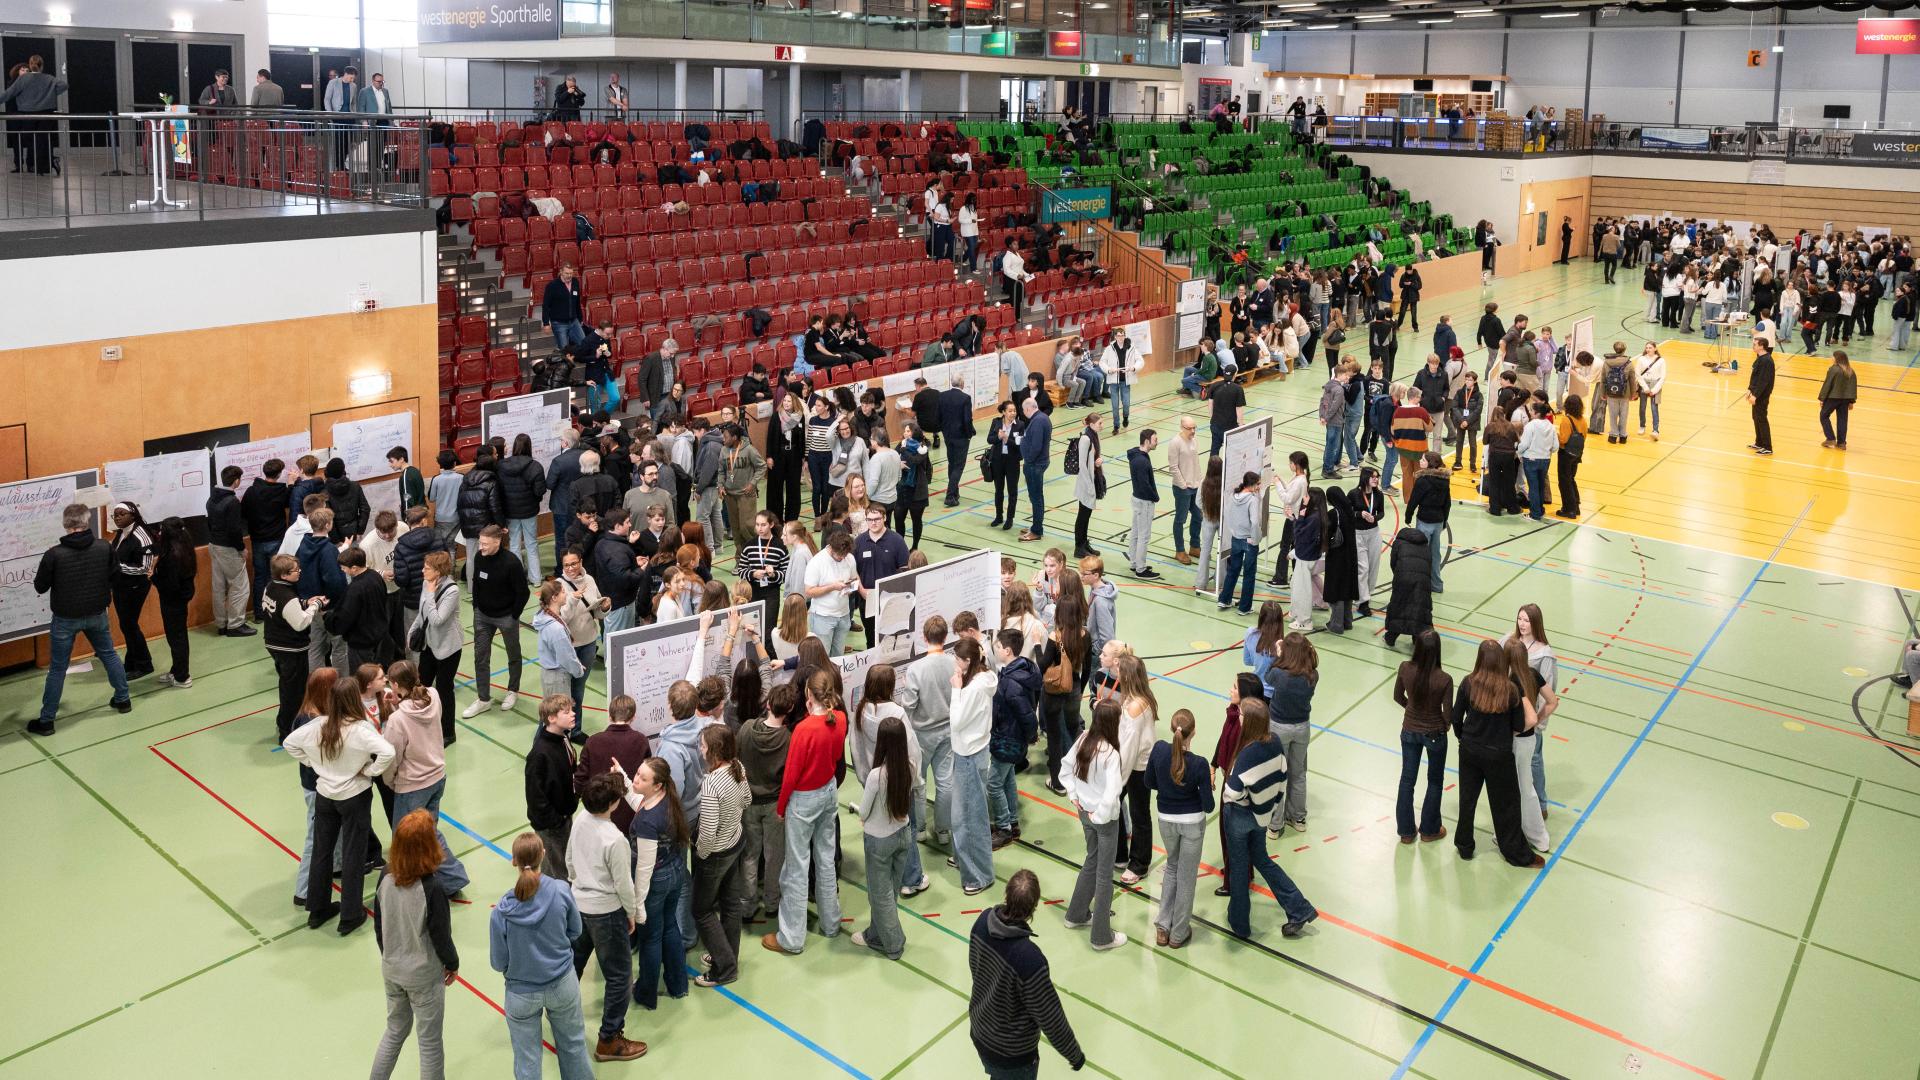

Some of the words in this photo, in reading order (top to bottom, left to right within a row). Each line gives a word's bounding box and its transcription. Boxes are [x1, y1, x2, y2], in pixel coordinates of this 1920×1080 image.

[421, 7, 486, 28] westenergie
[490, 3, 552, 27] Sporthalle
[1863, 33, 1916, 42] westenergie
[782, 47, 791, 60] A
[1752, 54, 1761, 66] C
[657, 635, 699, 658] Nahverke
